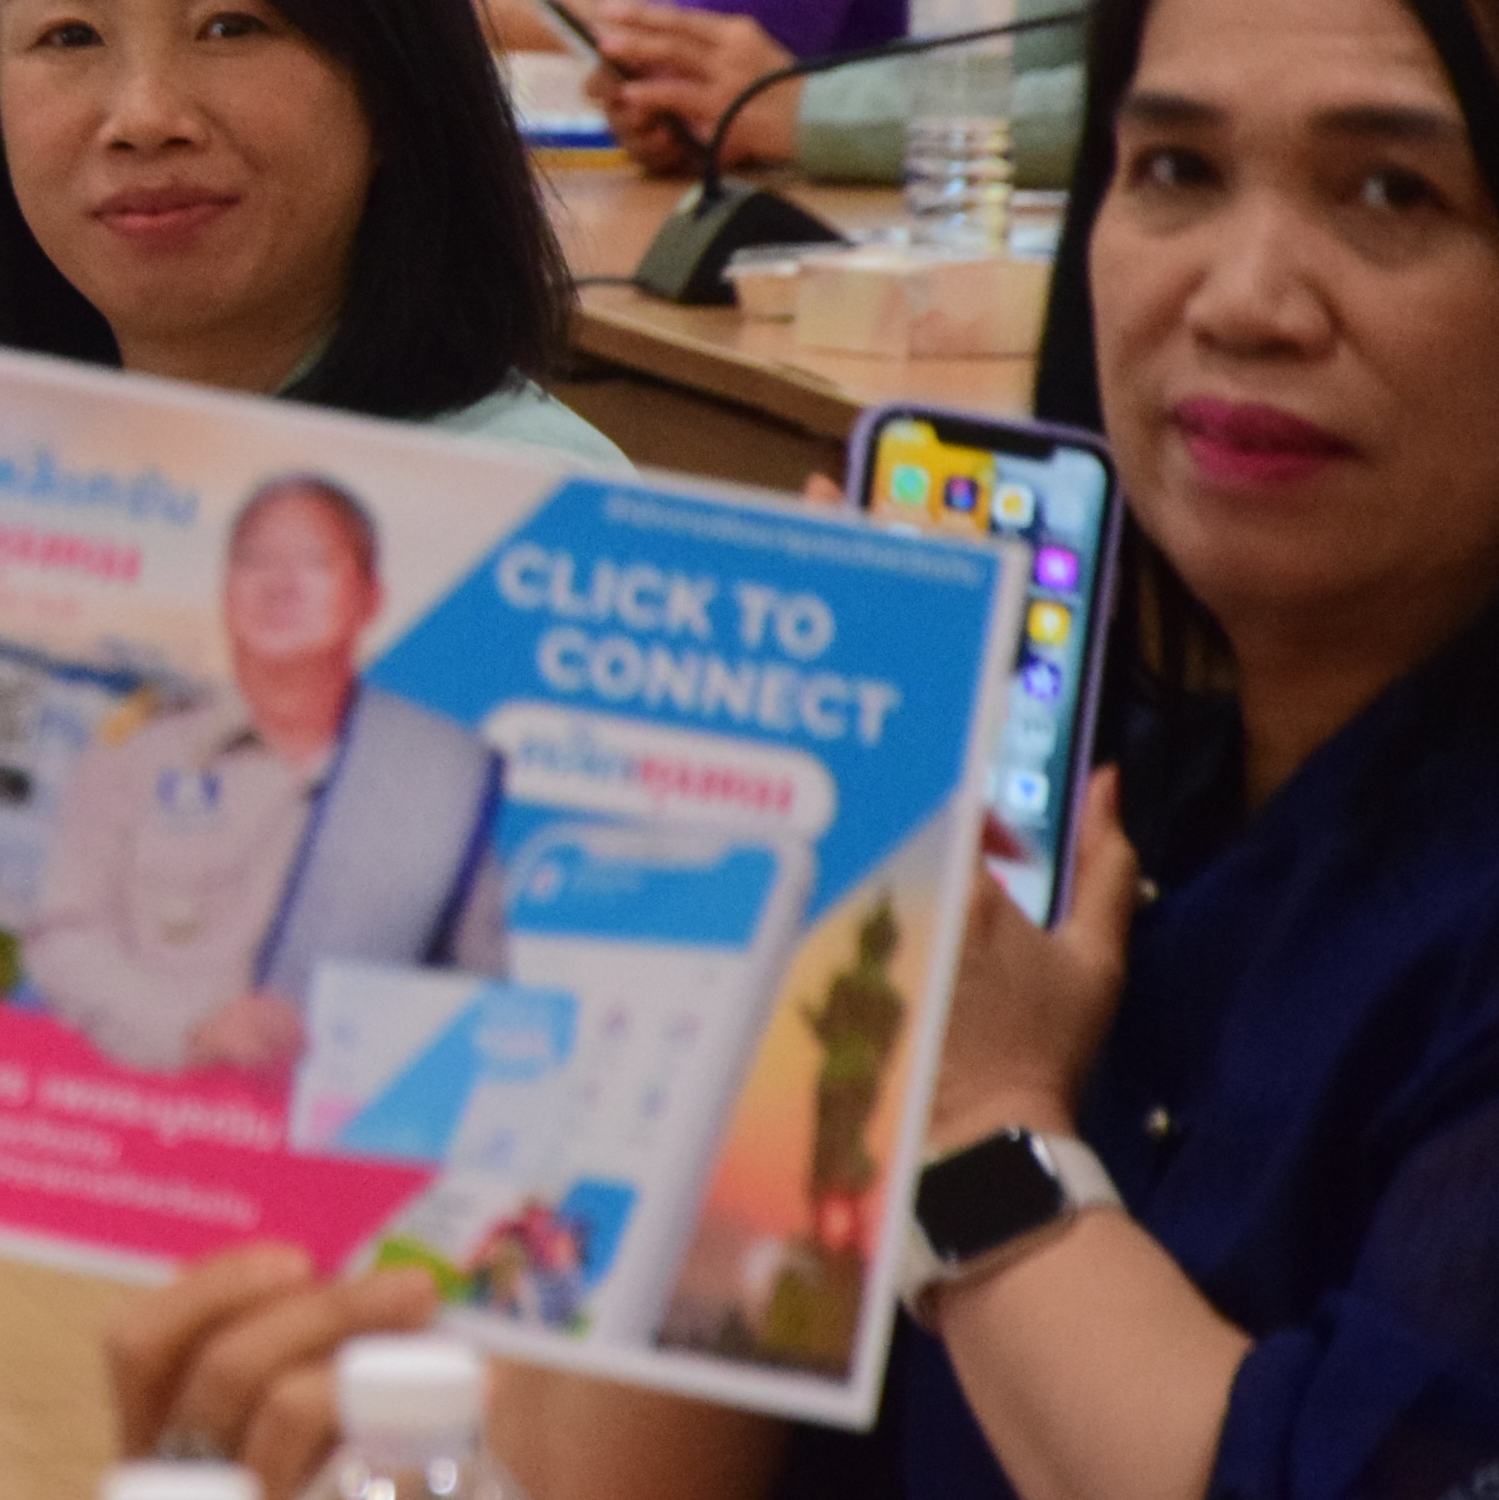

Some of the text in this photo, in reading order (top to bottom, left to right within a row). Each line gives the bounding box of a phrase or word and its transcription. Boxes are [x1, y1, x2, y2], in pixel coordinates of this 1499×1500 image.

[496, 540, 719, 642] CLICK
[735, 578, 834, 660] TO
[536, 625, 901, 748] CONNECT
